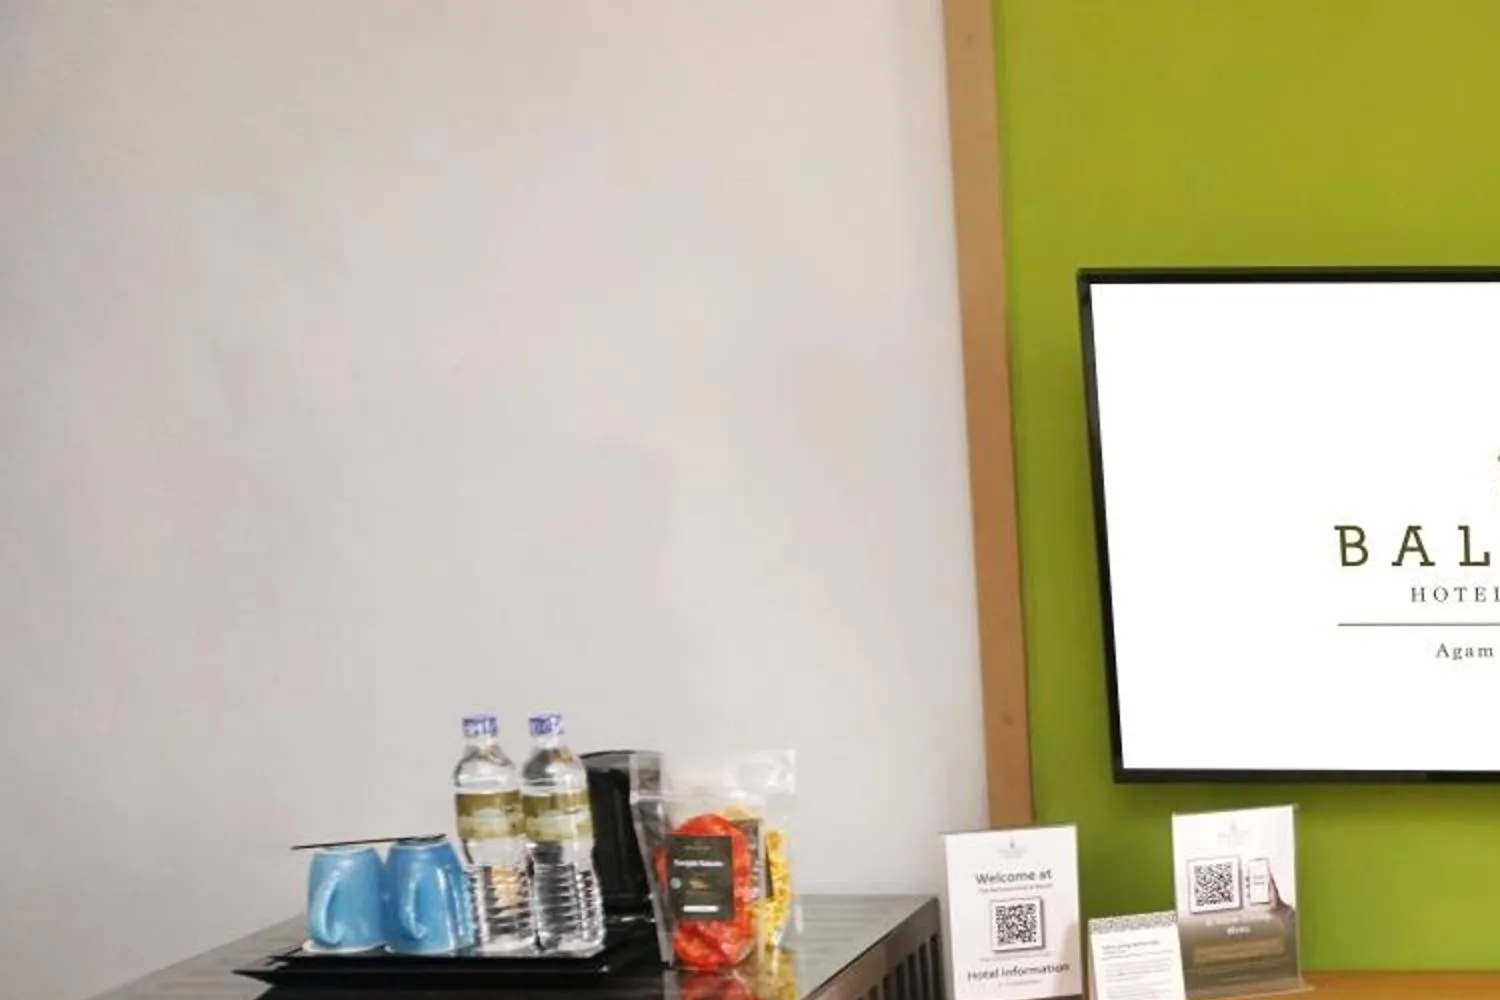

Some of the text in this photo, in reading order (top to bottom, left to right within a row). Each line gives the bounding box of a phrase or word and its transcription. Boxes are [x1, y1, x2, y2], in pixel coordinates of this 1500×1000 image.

[1435, 642, 1494, 660] Agam
[975, 868, 1052, 885] Welcome at
[967, 962, 1070, 982] Hotel Information
